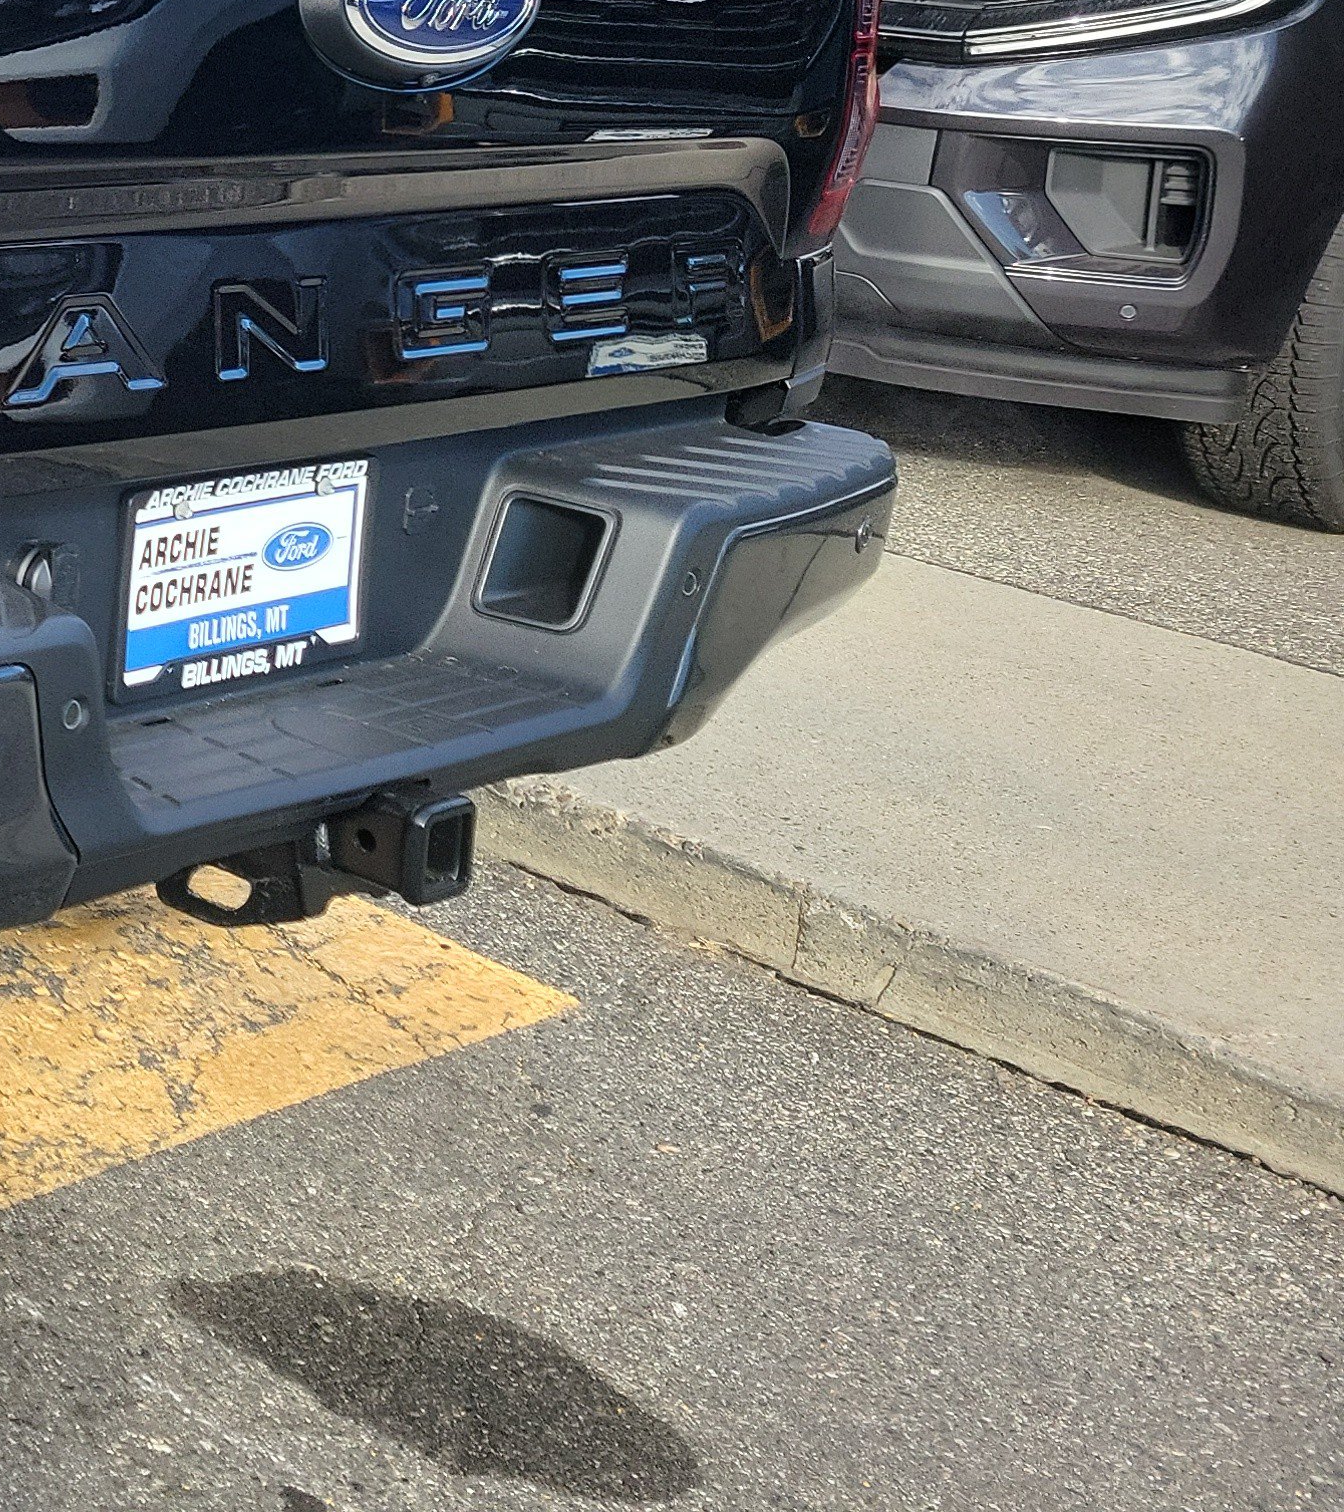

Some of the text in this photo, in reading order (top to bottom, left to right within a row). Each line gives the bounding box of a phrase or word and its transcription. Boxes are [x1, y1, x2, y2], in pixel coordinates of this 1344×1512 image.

[145, 460, 369, 510] ARCHIE COCHRANE FORD
[138, 526, 221, 571] ARCHIE
[274, 529, 319, 565] Ford
[135, 563, 255, 615] COCHRANE
[188, 604, 290, 650] BILLINGS, MT
[181, 640, 308, 689] BILLINGS, MT
